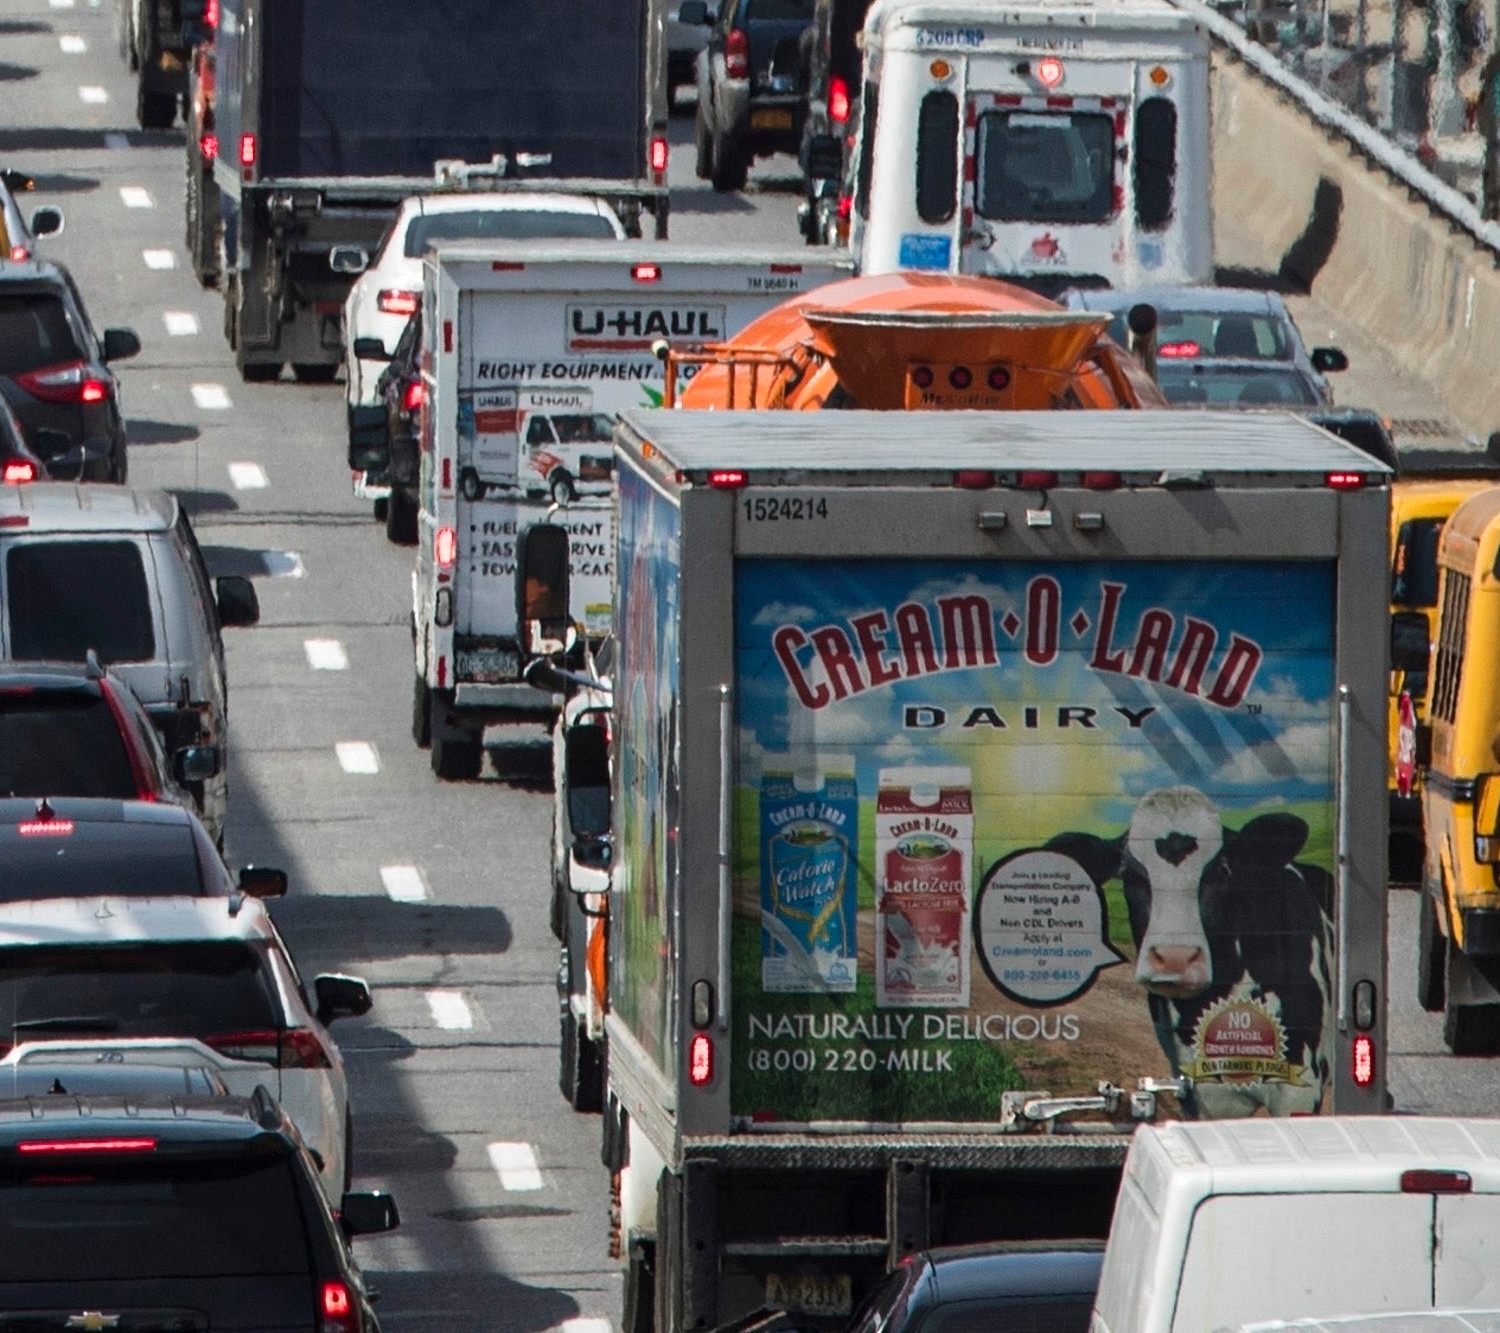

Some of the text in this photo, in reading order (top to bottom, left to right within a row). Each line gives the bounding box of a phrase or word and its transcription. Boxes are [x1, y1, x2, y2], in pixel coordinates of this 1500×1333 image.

[572, 309, 719, 336] U-HAUL
[477, 362, 537, 380] RIGHT
[743, 497, 828, 522] 1524214
[904, 706, 1160, 729] DAIRY
[884, 876, 965, 895] LactoZero
[1003, 895, 1026, 904] Now
[749, 1014, 1081, 1041] NATURALLY DELICIOUS
[1228, 1011, 1251, 1029] NO
[749, 1049, 953, 1073] (800) 220-MILK
